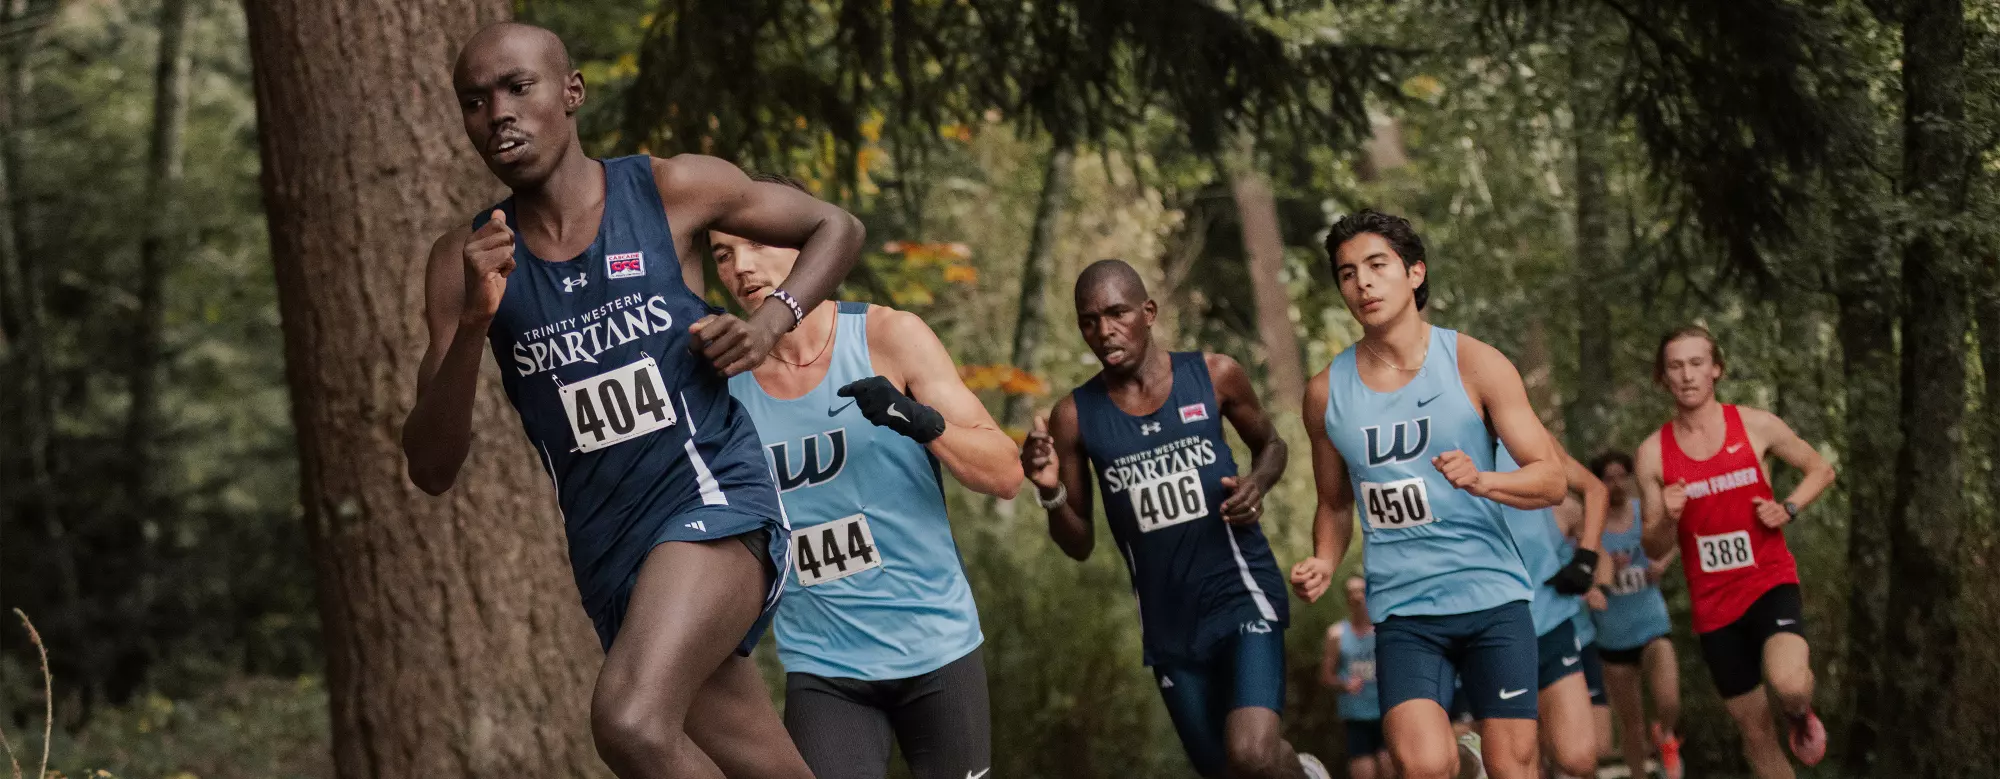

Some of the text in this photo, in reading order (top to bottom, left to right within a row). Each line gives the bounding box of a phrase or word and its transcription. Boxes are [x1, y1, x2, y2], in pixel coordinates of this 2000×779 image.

[513, 295, 673, 378] SPARTANS
[524, 292, 643, 342] TRINITY WESTERN
[575, 367, 665, 442] 404
[1104, 439, 1216, 493] SPARTANS
[1114, 435, 1200, 467] TRINITY WESTERN
[1360, 416, 1431, 469] W
[1140, 475, 1200, 525] 406
[1369, 484, 1426, 525] 450
[1709, 467, 1758, 494] FRASER
[797, 520, 873, 579] 444
[1703, 537, 1748, 567] 388
